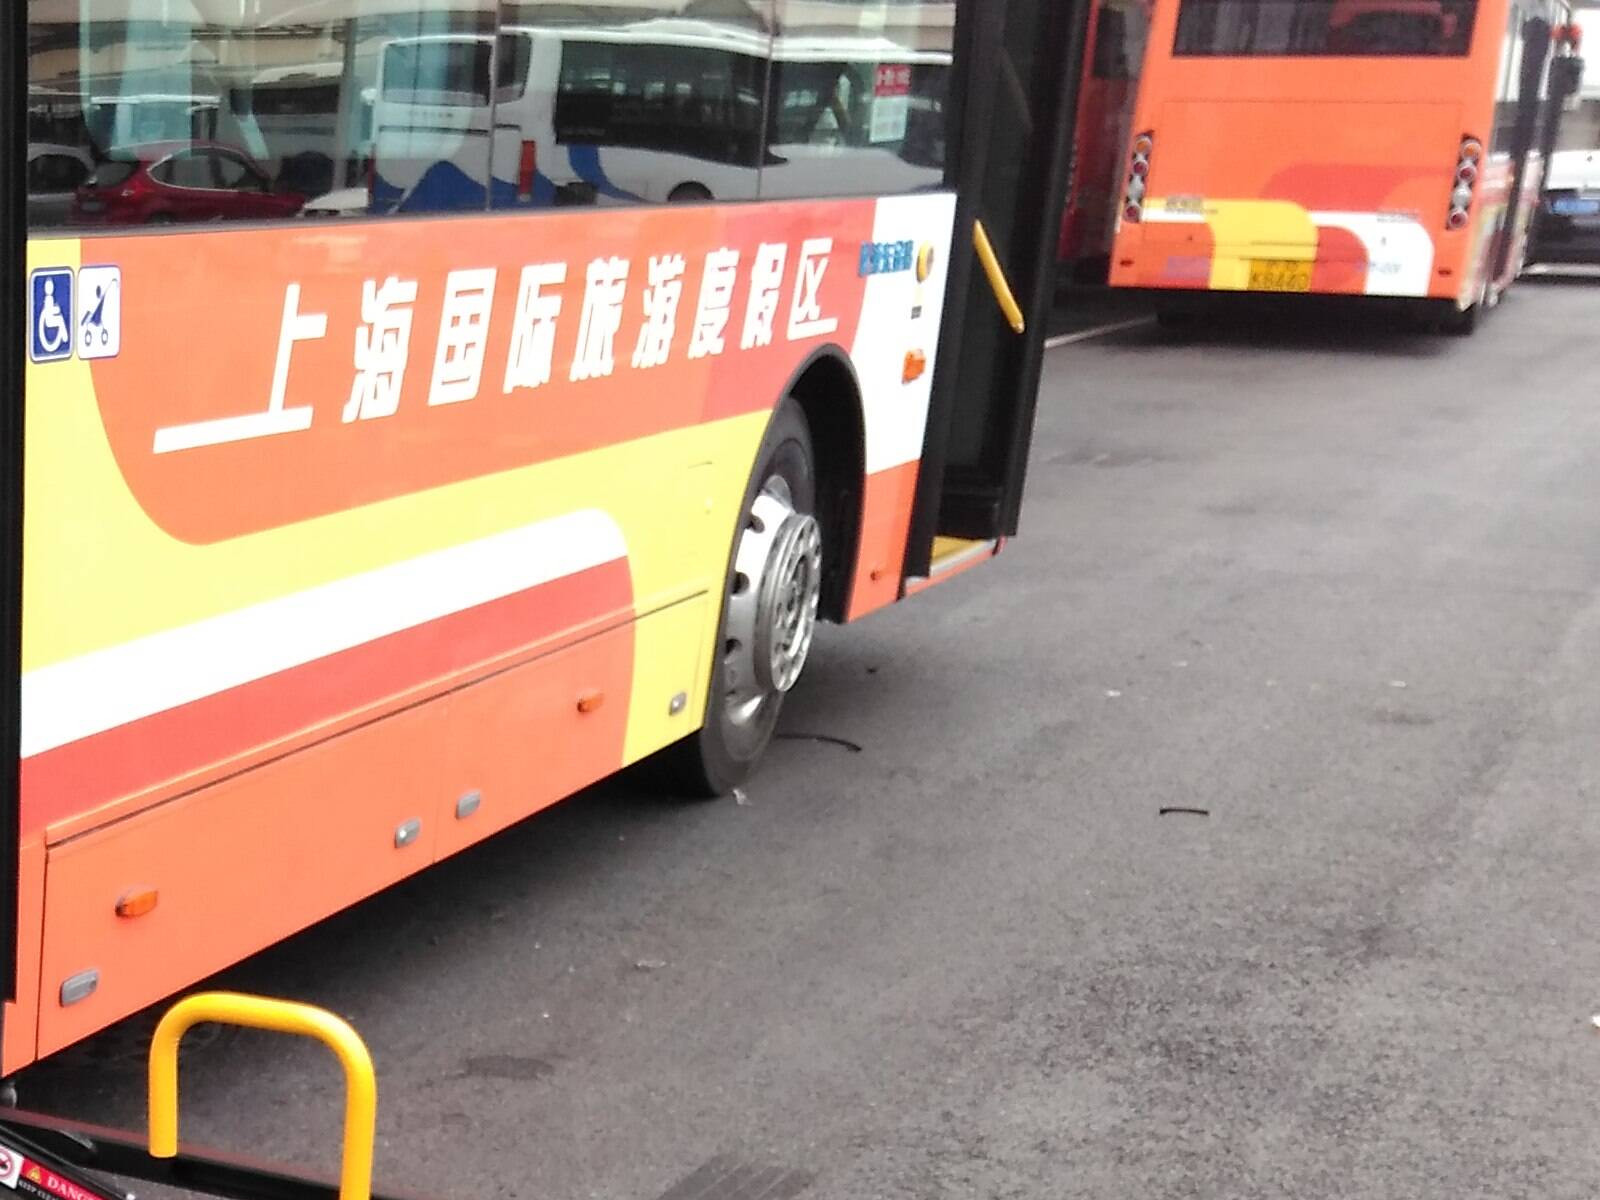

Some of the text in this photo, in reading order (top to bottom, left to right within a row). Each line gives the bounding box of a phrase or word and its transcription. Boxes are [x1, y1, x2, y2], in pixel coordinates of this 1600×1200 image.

[153, 238, 840, 454] 上海国际旅游度假区
[18, 1180, 37, 1194] KEEP
